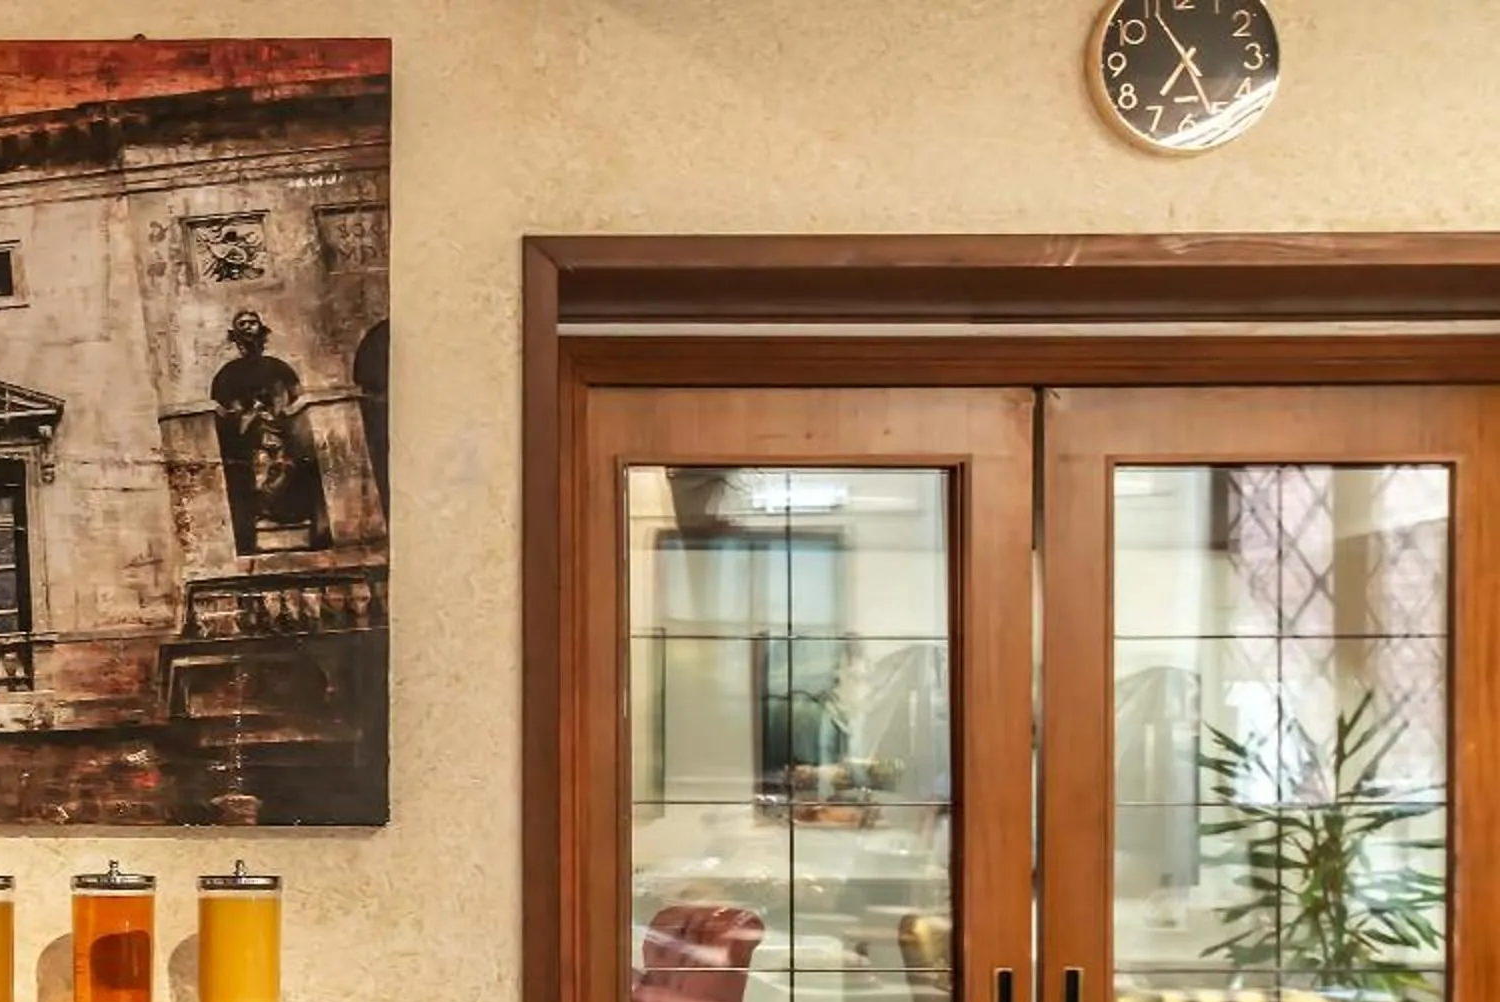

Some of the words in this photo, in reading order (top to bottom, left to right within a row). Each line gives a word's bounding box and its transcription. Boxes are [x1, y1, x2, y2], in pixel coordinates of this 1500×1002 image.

[1117, 19, 1147, 46] 10
[1231, 9, 1252, 37] 2
[1107, 52, 1127, 78] 9
[1243, 43, 1264, 70] 3
[1118, 83, 1137, 109] 8
[1234, 77, 1252, 99] 4
[1146, 106, 1164, 132] 7
